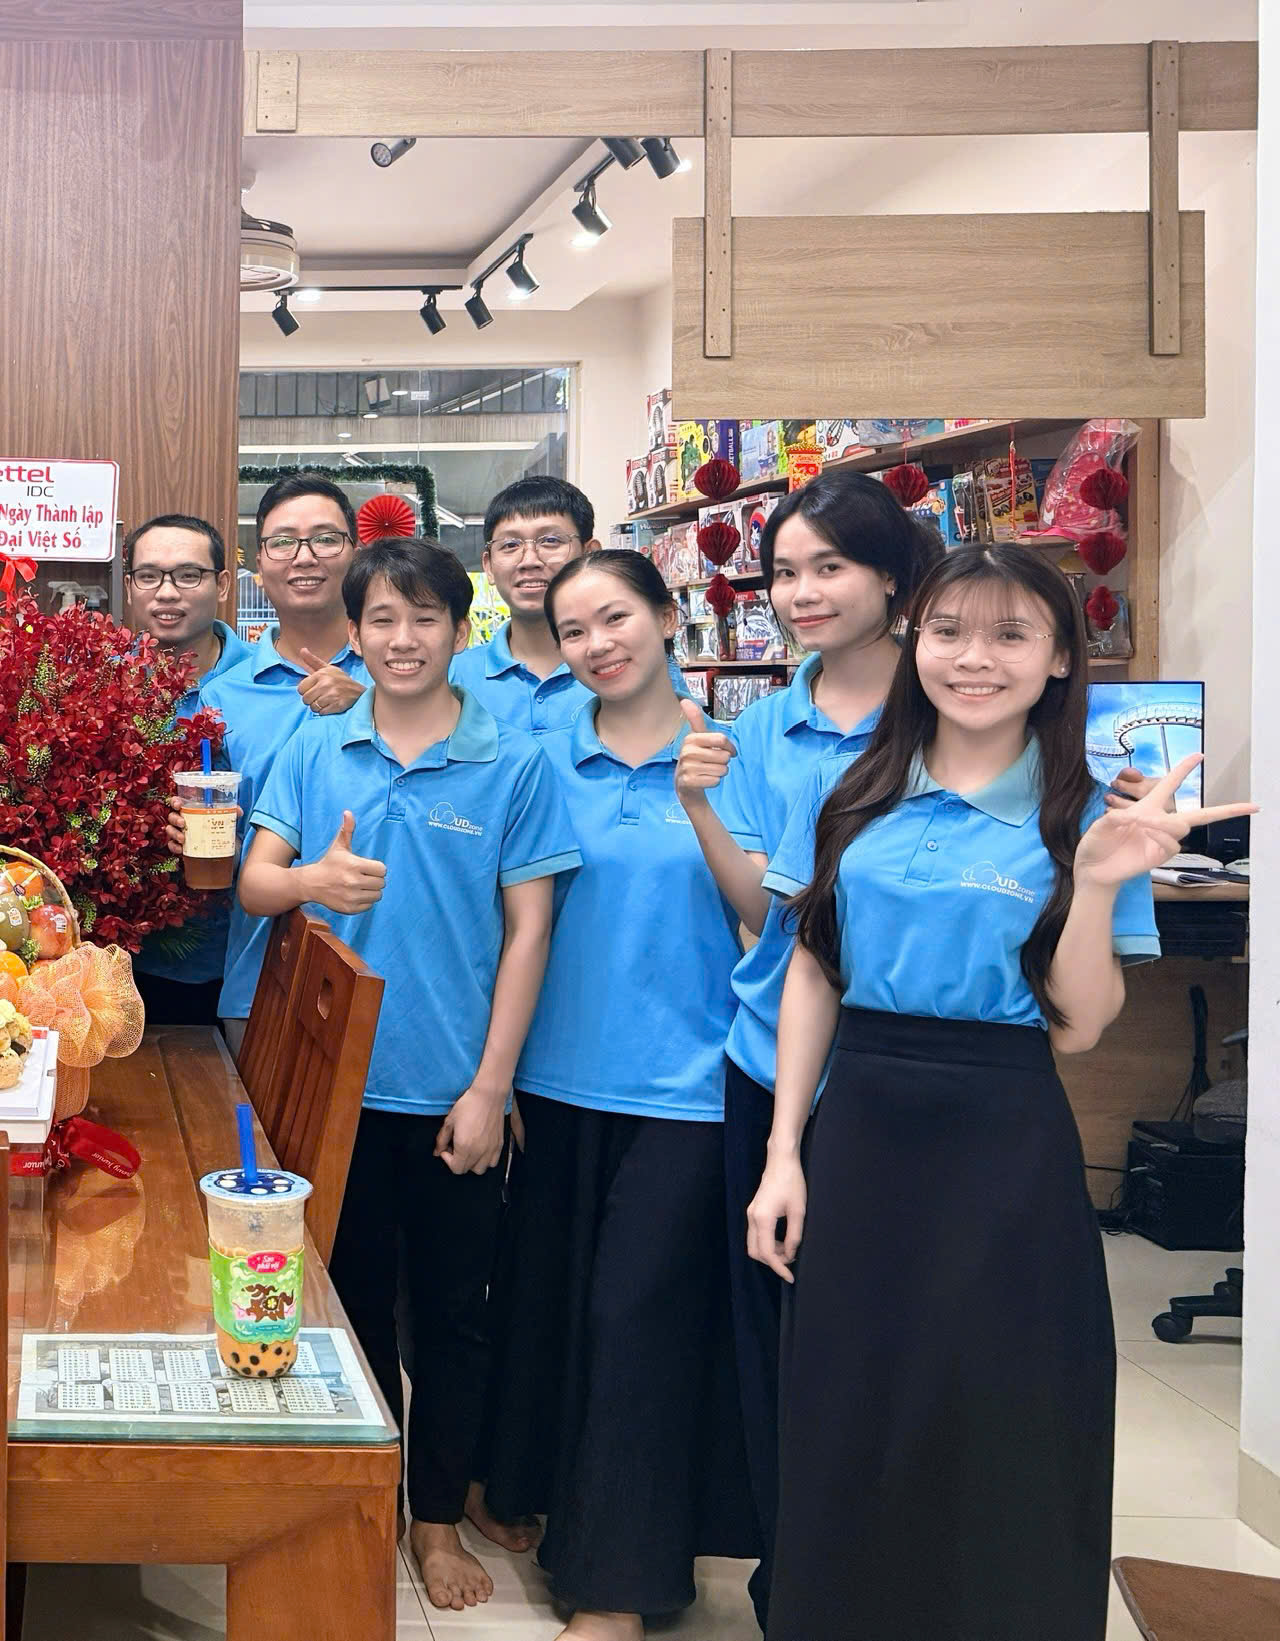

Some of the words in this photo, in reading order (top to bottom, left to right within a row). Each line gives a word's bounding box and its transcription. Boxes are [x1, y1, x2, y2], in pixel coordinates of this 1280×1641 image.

[26, 485, 55, 498] IDC
[36, 504, 78, 523] Thành
[82, 505, 104, 529] lập
[28, 530, 58, 553] Việt
[63, 527, 82, 549] Số
